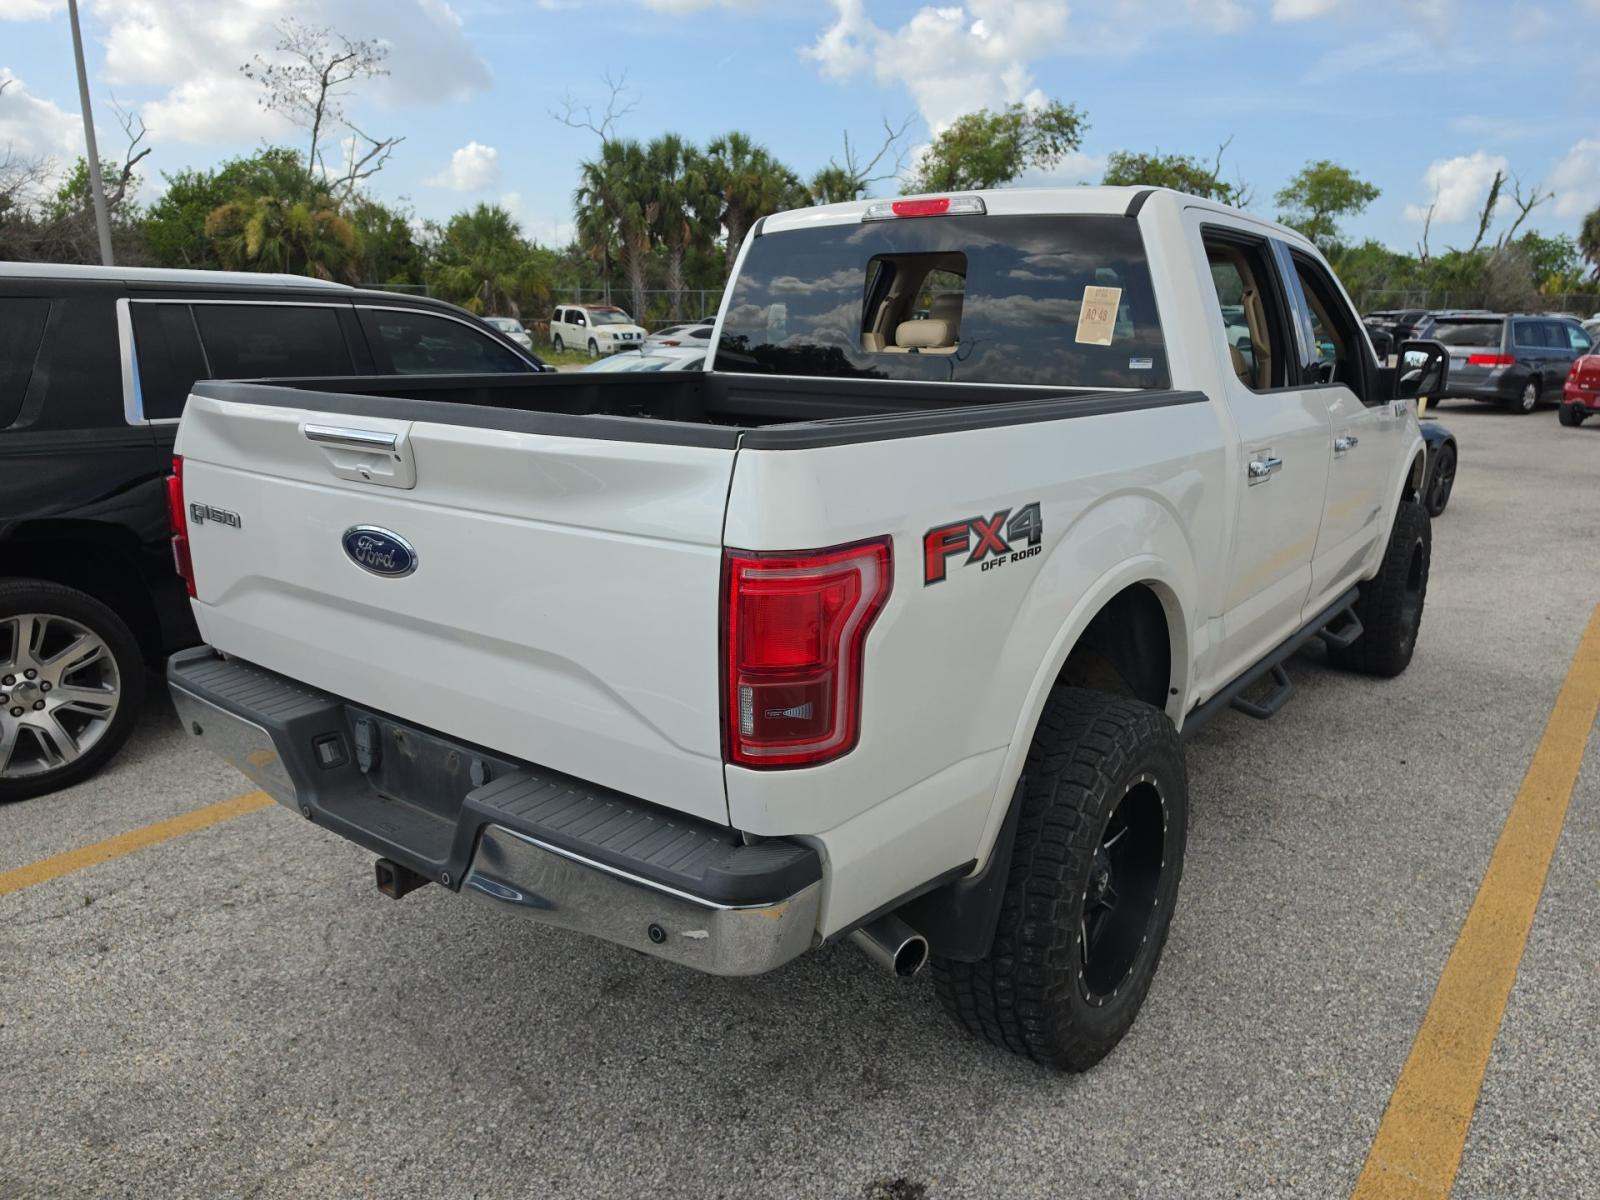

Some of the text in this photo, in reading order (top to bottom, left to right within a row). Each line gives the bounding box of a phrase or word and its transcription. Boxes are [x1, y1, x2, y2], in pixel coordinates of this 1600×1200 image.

[923, 501, 1043, 588] FX4
[981, 545, 1042, 572] OFF ROAD
